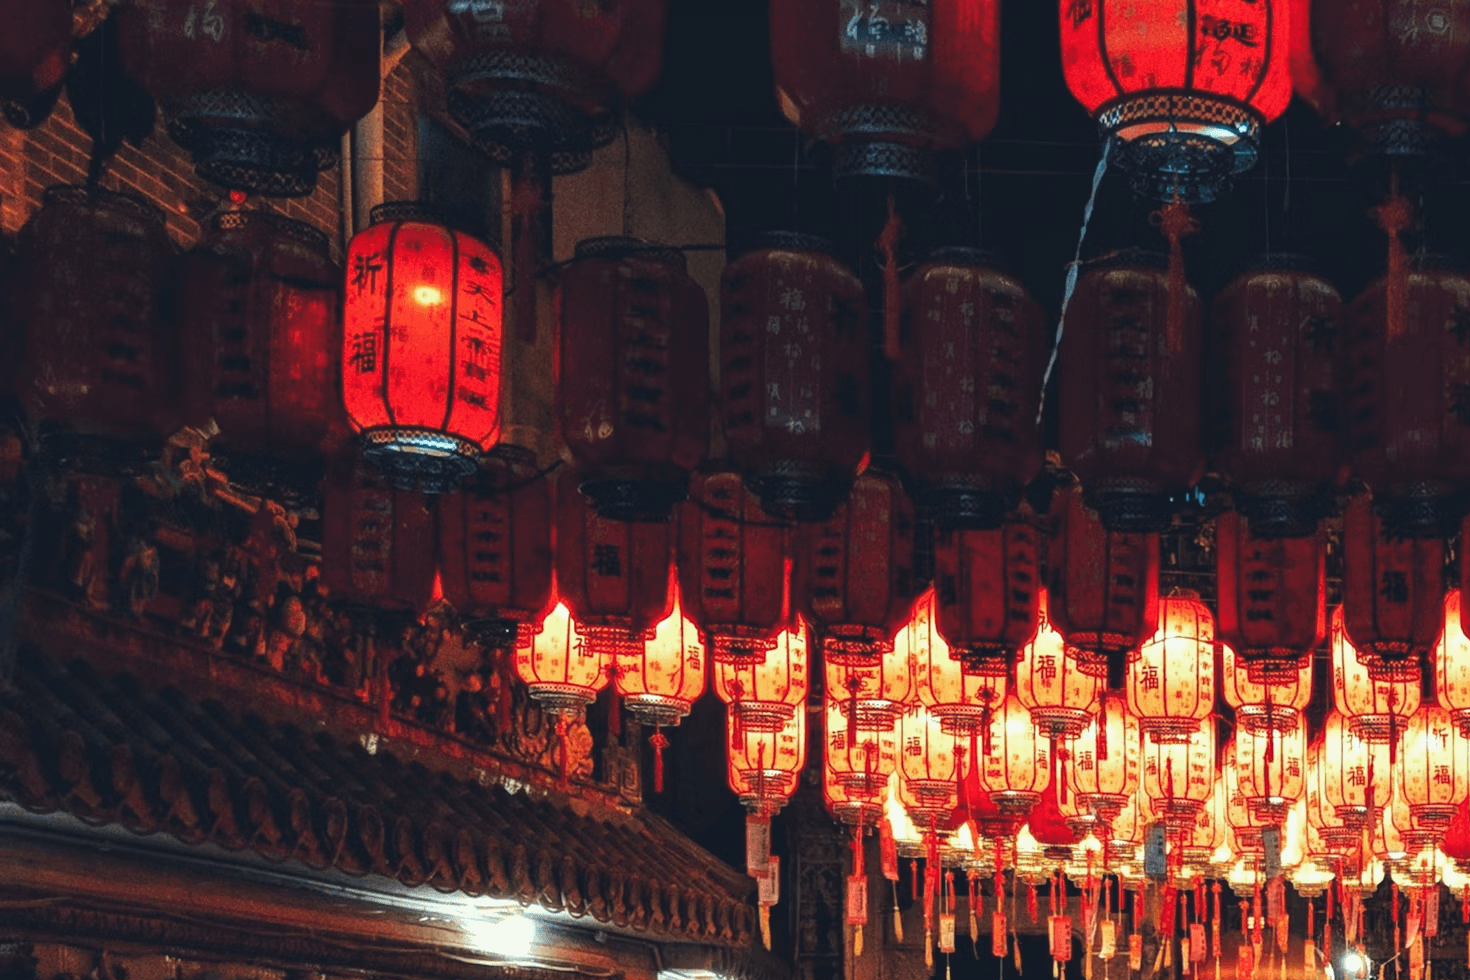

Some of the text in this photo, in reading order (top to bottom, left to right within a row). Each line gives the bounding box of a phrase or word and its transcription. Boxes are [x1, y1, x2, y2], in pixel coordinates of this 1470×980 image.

[348, 253, 382, 375] 祈福
[591, 545, 621, 578] 福
[1139, 665, 1159, 690] 福
[1077, 750, 1094, 772] 福
[1432, 727, 1451, 785] 祈福
